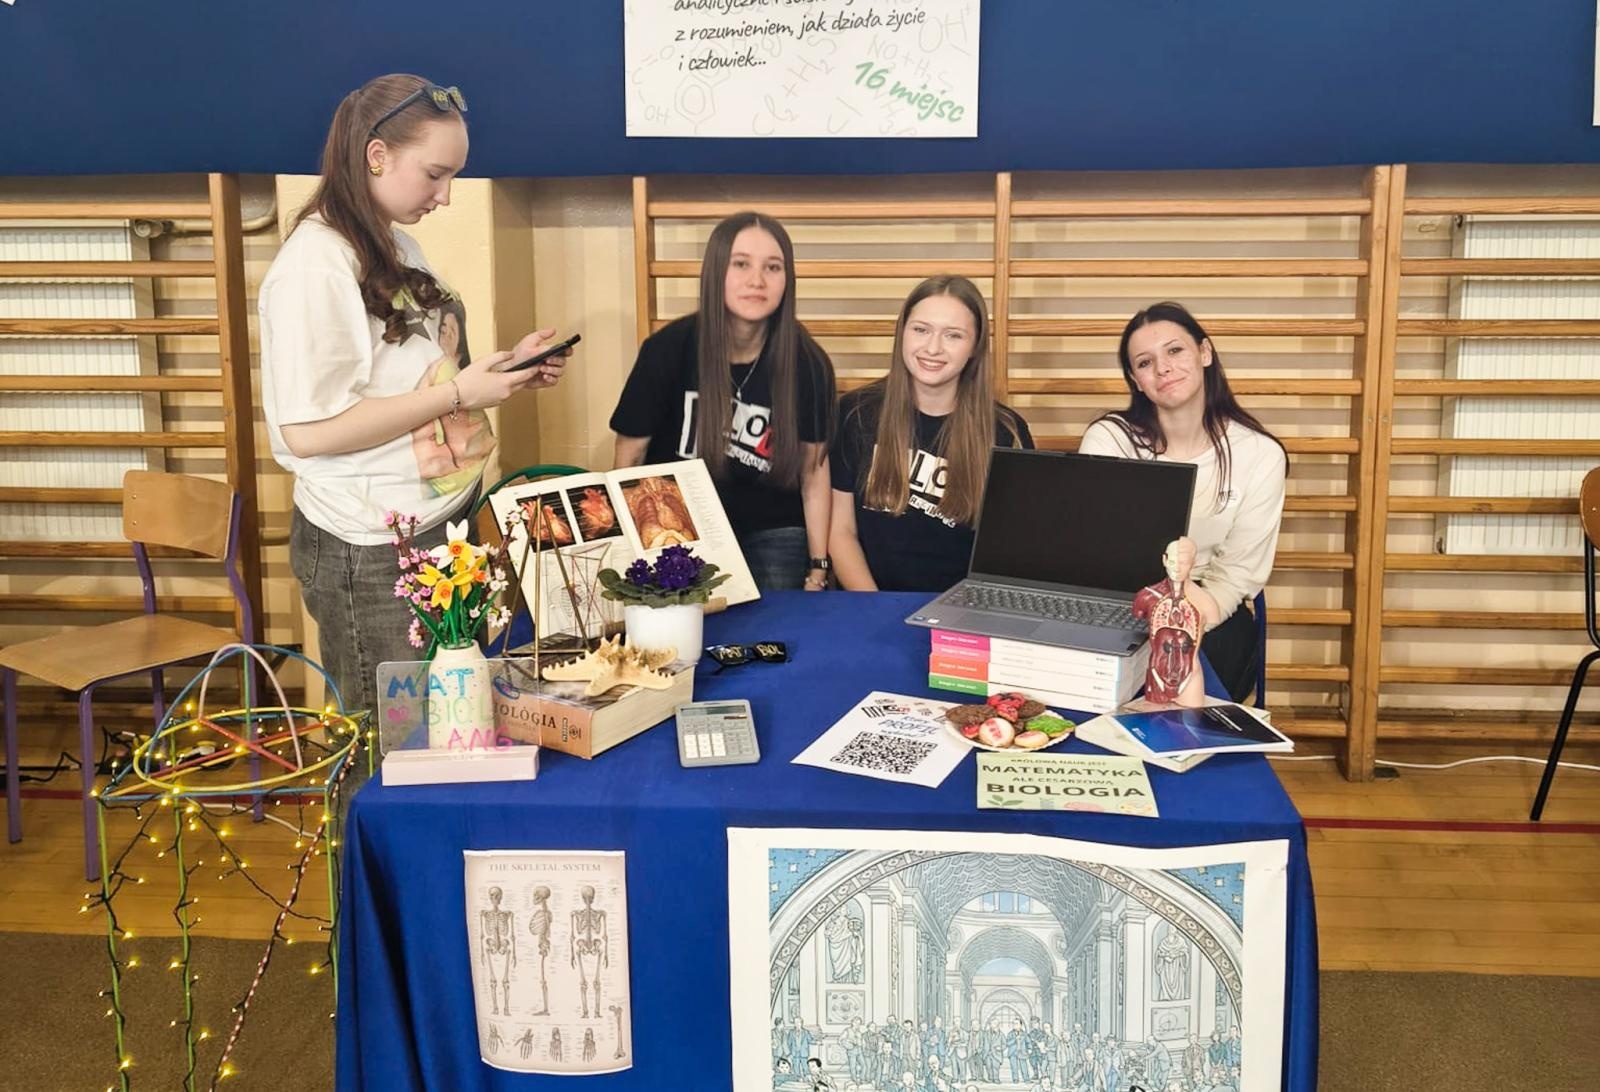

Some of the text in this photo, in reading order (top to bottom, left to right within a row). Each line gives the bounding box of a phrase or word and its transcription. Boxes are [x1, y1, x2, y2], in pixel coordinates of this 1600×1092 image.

[674, 8, 926, 41] z rozumieniem, jak działa życie
[678, 46, 767, 71] i człowiek...
[855, 61, 965, 122] 16 miejsc
[387, 668, 474, 698] MAT
[493, 702, 557, 729] IOLOGIA
[447, 726, 513, 751] ANG
[982, 765, 1143, 777] MATEMATYKA
[986, 783, 1146, 797] BIOLOGIA
[489, 863, 601, 872] THE SKELETAL SYSTEM
